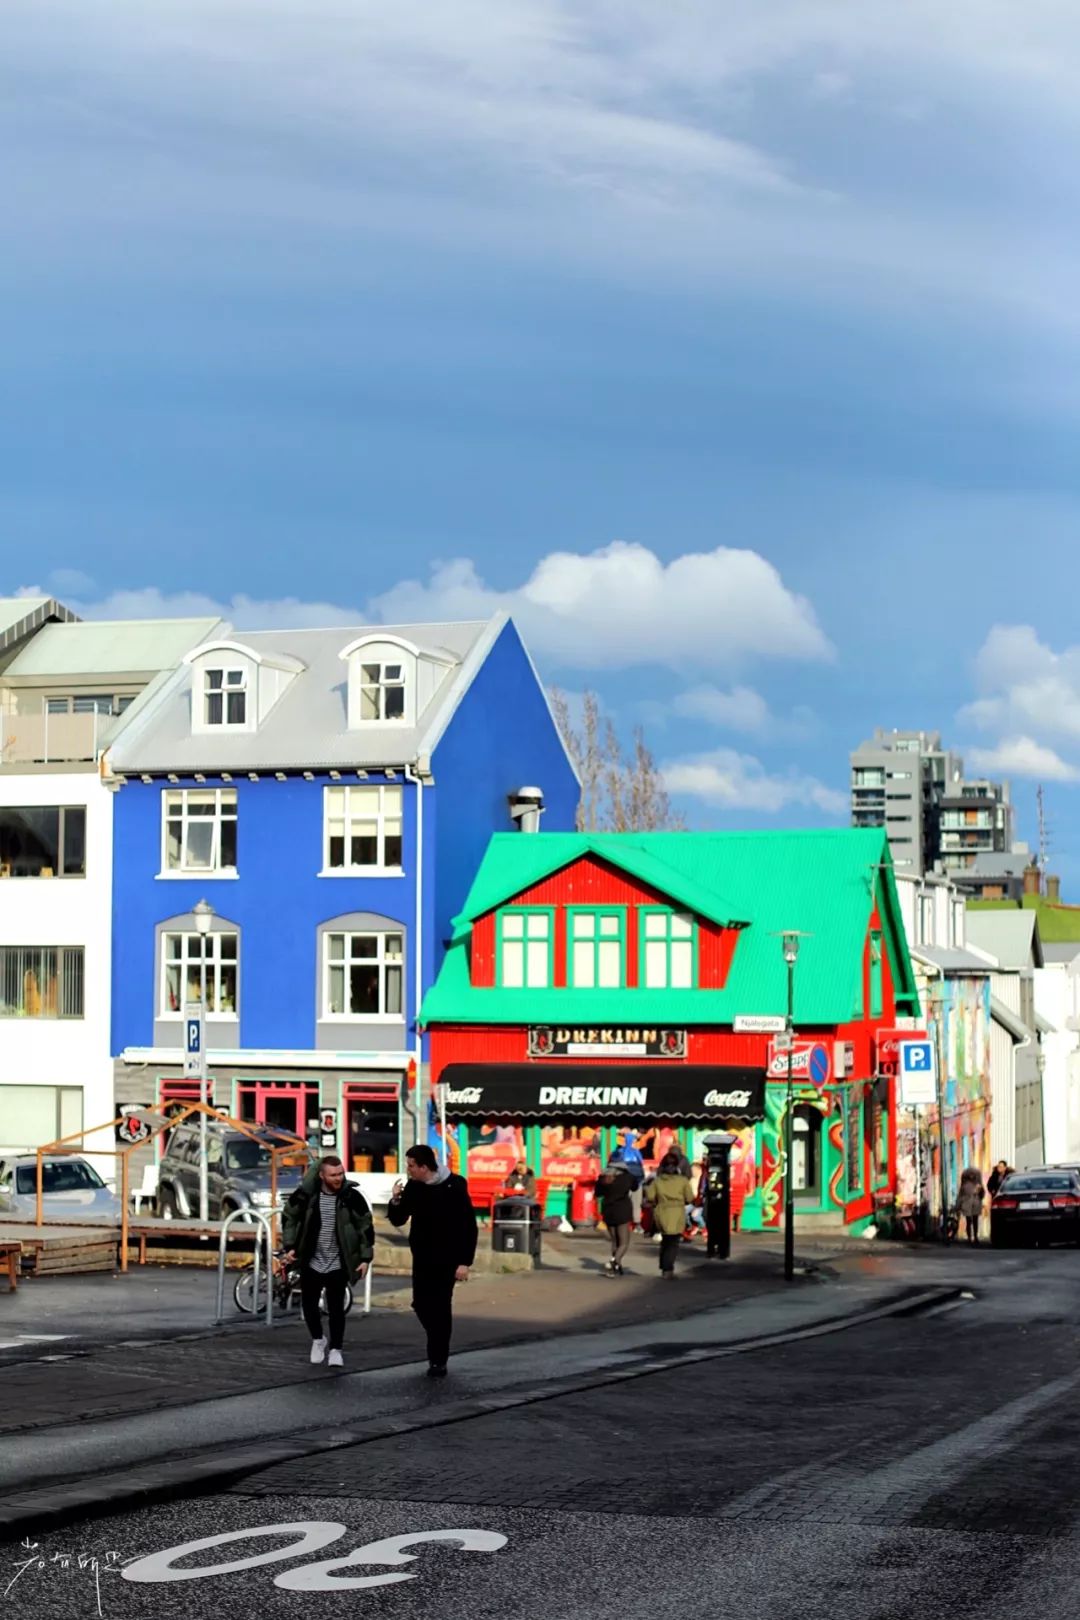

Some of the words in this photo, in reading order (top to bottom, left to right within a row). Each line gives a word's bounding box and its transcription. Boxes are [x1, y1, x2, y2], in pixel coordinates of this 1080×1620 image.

[555, 1029, 658, 1043] DREKINN
[910, 1047, 925, 1068] P
[538, 1086, 648, 1105] DREKINN
